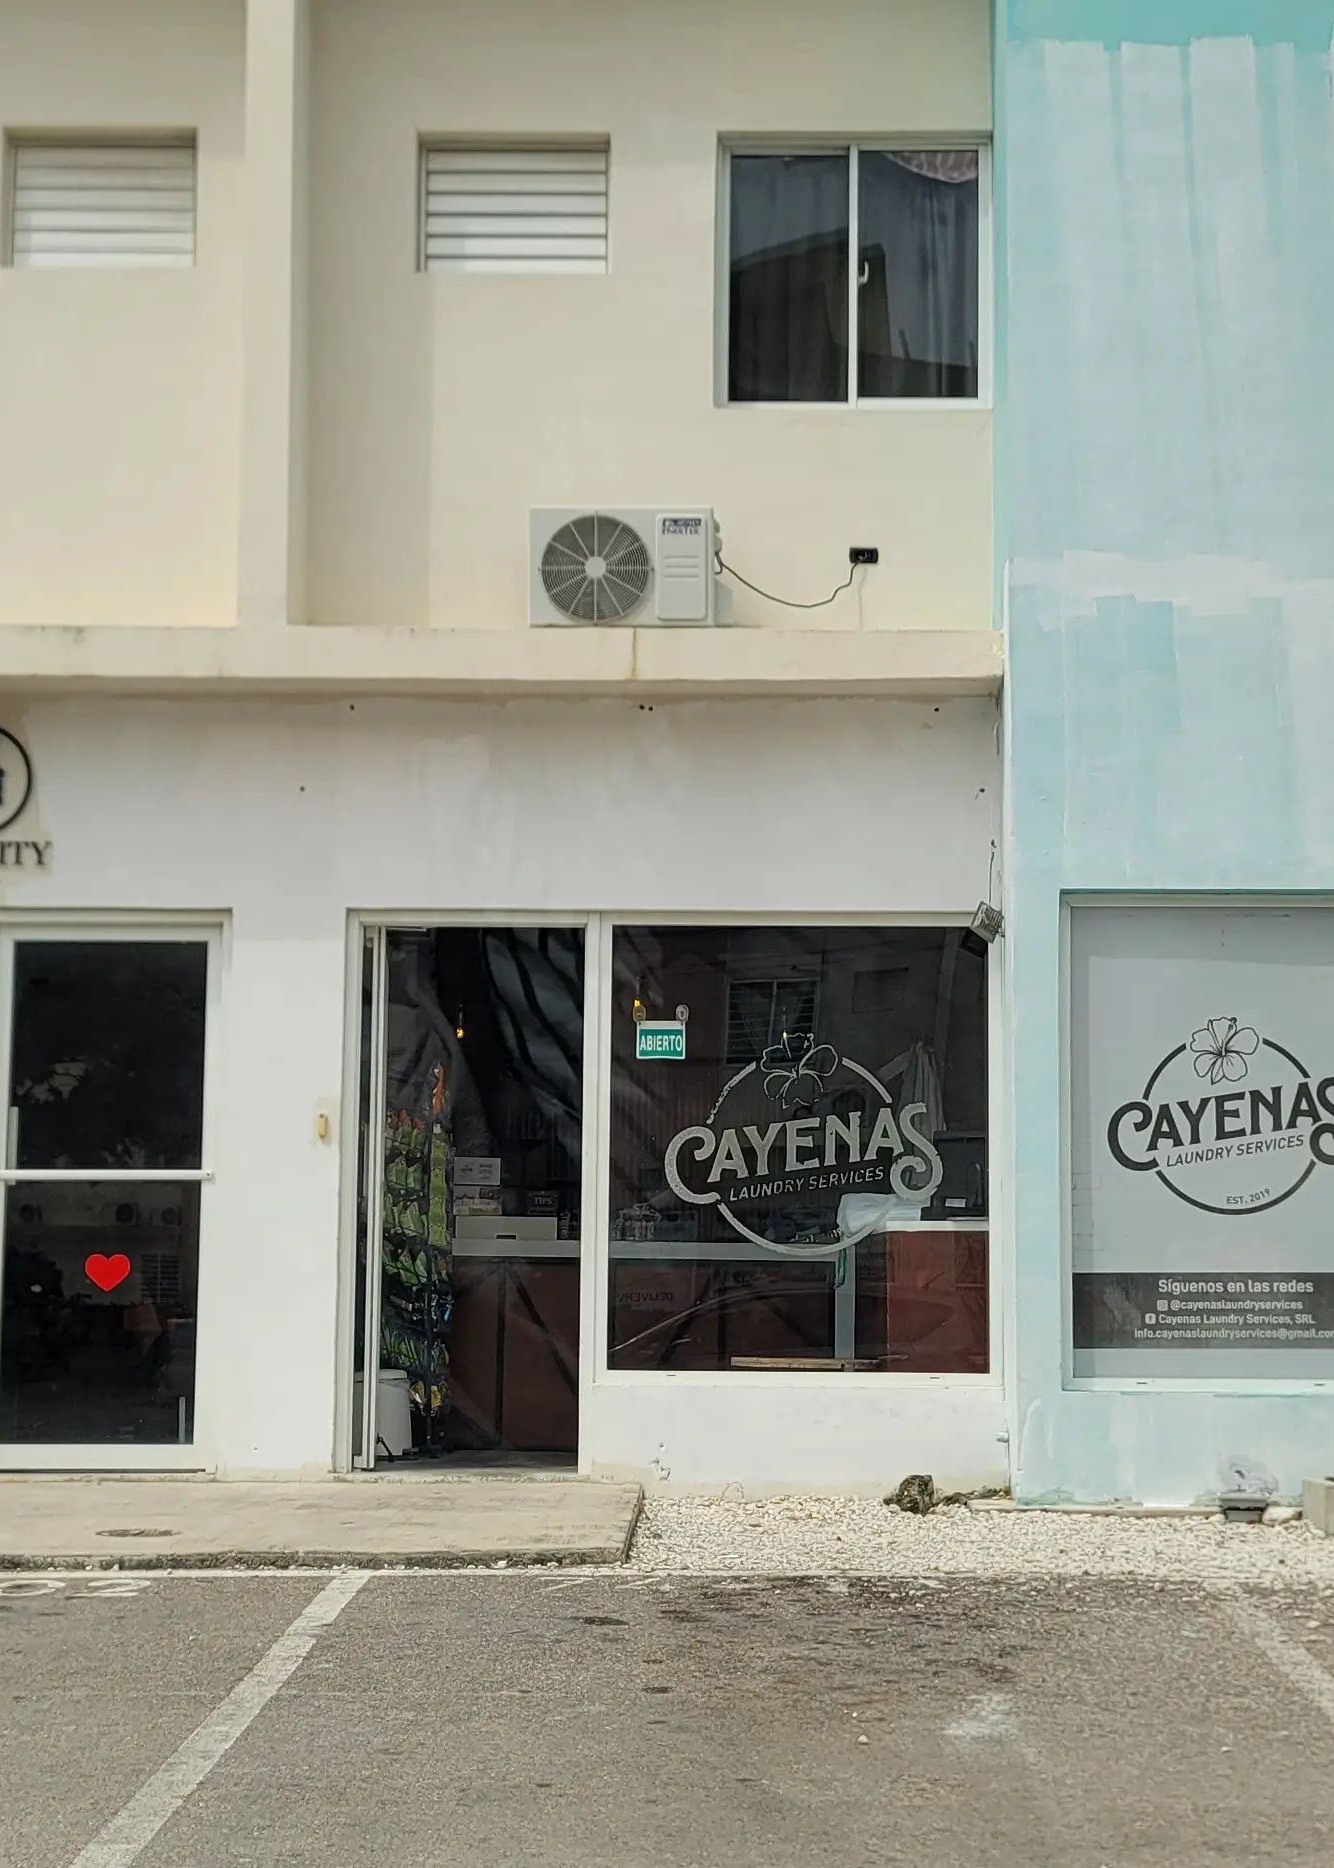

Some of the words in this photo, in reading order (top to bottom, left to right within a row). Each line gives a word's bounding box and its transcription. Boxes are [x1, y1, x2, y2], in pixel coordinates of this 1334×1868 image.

[639, 1034, 683, 1052] ABIERTO
[664, 1102, 944, 1205] CAYENAS
[1166, 1145, 1234, 1168] LAUNDRY
[1236, 1134, 1305, 1157] SERVICES
[729, 1177, 805, 1202] LAUNDRY
[808, 1166, 884, 1190] SERVICES
[1226, 1195, 1249, 1205] EST.
[1249, 1187, 1271, 1203] 2019
[1158, 1279, 1224, 1295] Síguenos
[1227, 1281, 1245, 1293] en
[1248, 1279, 1269, 1293] las
[1273, 1279, 1314, 1293] redes
[1170, 1299, 1303, 1312] @cayenaslaundryservices
[1158, 1314, 1201, 1326] Cayenas
[1203, 1314, 1244, 1326] Laundry
[1246, 1314, 1293, 1325] Services,
[1294, 1314, 1316, 1325] SRL
